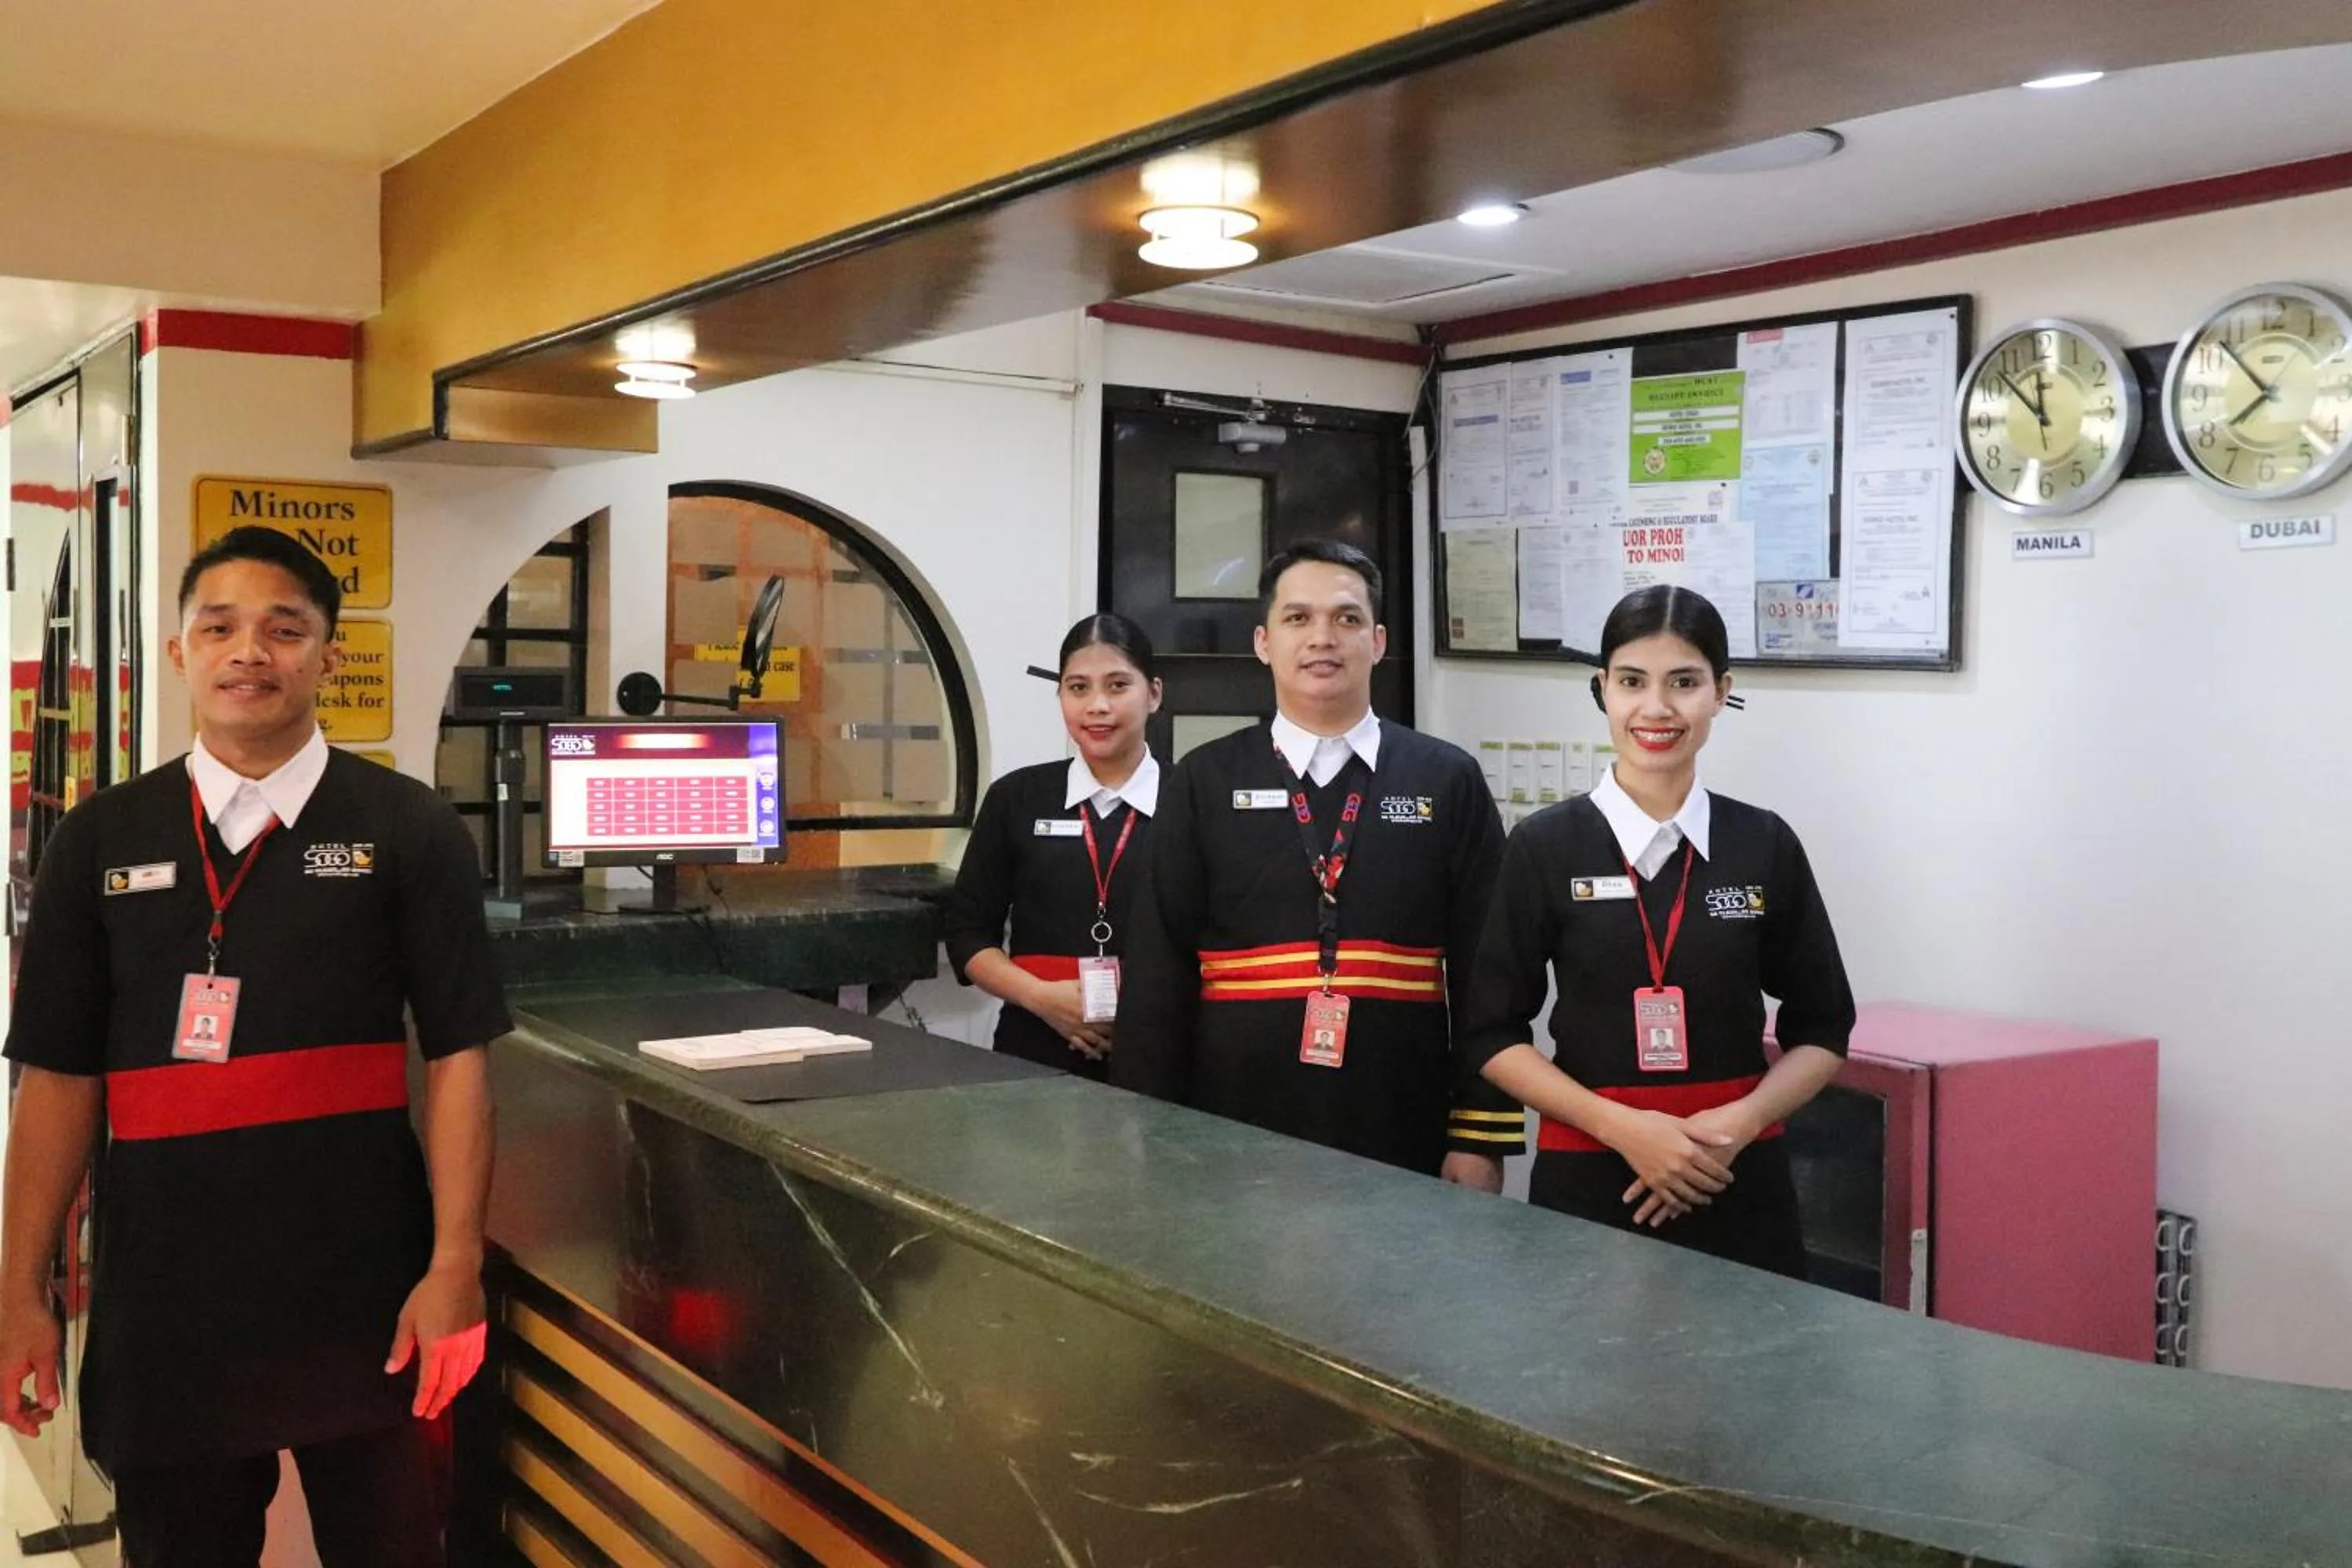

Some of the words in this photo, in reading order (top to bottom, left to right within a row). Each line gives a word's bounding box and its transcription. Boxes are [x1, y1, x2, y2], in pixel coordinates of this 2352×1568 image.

[2227, 317, 2245, 344] 11
[2307, 309, 2315, 337] 1
[2031, 334, 2053, 361] 12
[2071, 339, 2081, 365] 1
[2198, 344, 2223, 374] 10
[2002, 348, 2020, 374] 11
[2092, 361, 2107, 387] 2
[1981, 376, 2003, 402] 10
[2191, 385, 2207, 412] 9
[2100, 395, 2115, 423] 3
[1977, 412, 1991, 437] 9
[2199, 420, 2215, 448] 8
[2325, 414, 2343, 442] 4
[1987, 445, 2000, 470] 8
[2092, 434, 2109, 459] 4
[2225, 448, 2239, 474] 7
[2259, 453, 2275, 482] 6
[2009, 468, 2021, 492] 7
[2039, 472, 2054, 499] 6
[2071, 461, 2085, 488] 5
[230, 489, 356, 521] Minors
[297, 528, 361, 557] Not
[1624, 529, 1647, 547] UOR
[2250, 520, 2320, 539] DUBAI
[2016, 535, 2082, 552] MANILA
[1627, 550, 1644, 564] TO
[340, 652, 384, 667] your
[329, 674, 384, 689] apons
[358, 691, 385, 709] for
